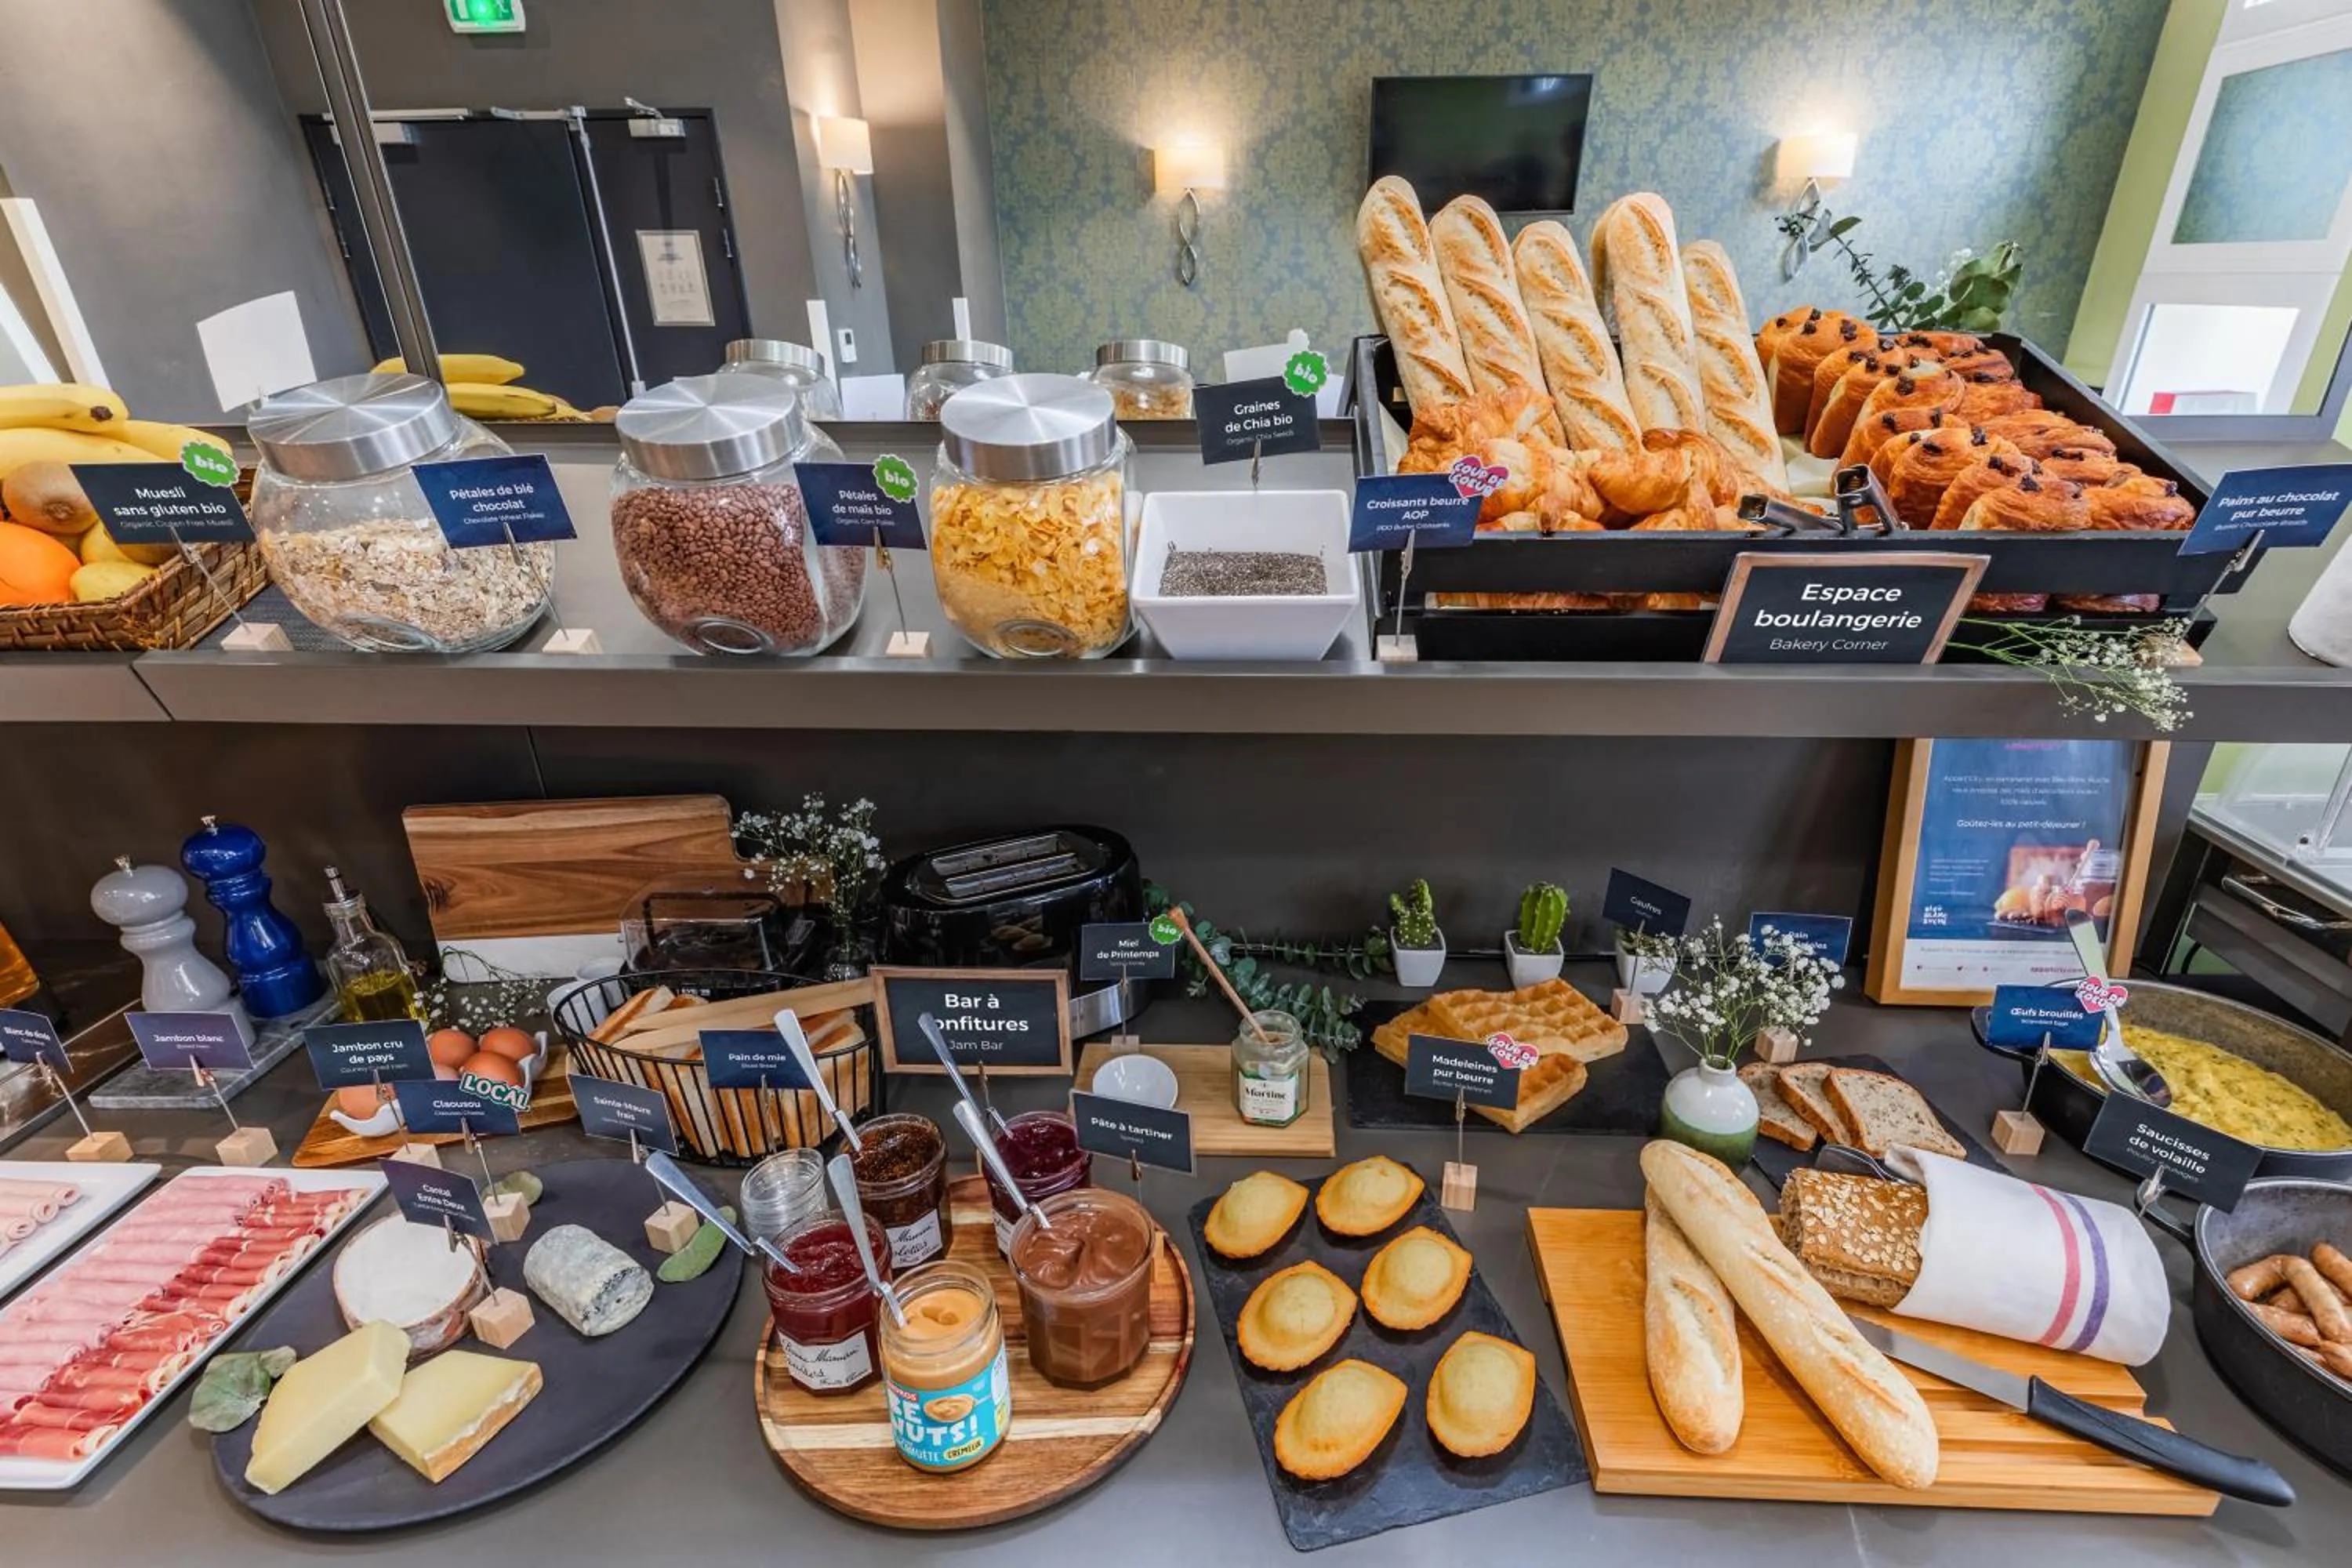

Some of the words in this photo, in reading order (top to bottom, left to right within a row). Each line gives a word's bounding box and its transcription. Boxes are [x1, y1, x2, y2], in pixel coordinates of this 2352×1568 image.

[1293, 363, 1318, 384] bio
[1234, 400, 1281, 416] Graines
[1225, 423, 1241, 434] de
[1243, 418, 1271, 431] Chia
[1273, 415, 1293, 426] bio
[194, 454, 228, 474] bio
[884, 469, 909, 488] bio
[1454, 463, 1487, 478] COUP
[1487, 474, 1506, 488] DE
[135, 486, 187, 500] Muesli
[449, 486, 495, 501] Pétales
[496, 483, 513, 496] de
[514, 481, 534, 495] blé
[838, 490, 878, 502] Pétales
[473, 499, 526, 514] chocolat
[1367, 498, 1427, 510] Croissants
[1429, 496, 1471, 508] beurre
[2217, 495, 2256, 509] Pains
[2256, 495, 2274, 505] au
[2276, 490, 2340, 503] chocolat
[113, 506, 147, 517] sans
[150, 503, 199, 518] gluten
[200, 503, 227, 515] bio
[832, 503, 845, 514] de
[848, 504, 873, 515] maïs
[874, 504, 892, 516] bio
[1401, 510, 1429, 521] AOP
[2230, 510, 2259, 522] pur
[2259, 506, 2305, 518] beurre
[1801, 583, 1902, 605] Espace
[1754, 609, 1923, 633] boulangerie
[1769, 638, 1829, 653] Bakery
[1832, 638, 1889, 652] Corner
[1156, 923, 1178, 936] bio
[1118, 939, 1140, 949] Miel
[1110, 950, 1160, 961] Printemps
[945, 993, 982, 1009] Bar
[987, 993, 1001, 1010] à
[2010, 1007, 2038, 1018] Œufs
[2038, 1009, 2083, 1020] brouillés
[934, 1015, 1029, 1032] onfitures
[153, 1034, 195, 1043] Jambon
[195, 1033, 225, 1043] blanc
[949, 1040, 978, 1051] Jam
[981, 1040, 1005, 1051] Bar
[332, 1041, 381, 1054] Jambon
[383, 1040, 404, 1051] cru
[349, 1054, 365, 1065] de
[367, 1053, 395, 1066] pays
[728, 1053, 752, 1063] Pain
[753, 1053, 767, 1063] de
[767, 1053, 787, 1063] mie
[1432, 1054, 1498, 1075] Madeleines
[1432, 1068, 1454, 1080] pur
[1455, 1070, 1494, 1085] beurre
[464, 1075, 531, 1110] LOCAL
[1091, 1116, 1117, 1131] Pâte
[1119, 1121, 1127, 1134] à
[1128, 1124, 1174, 1142] tartiner
[2136, 1123, 2211, 1162] Saucisses
[2128, 1136, 2150, 1149] de
[2151, 1146, 2206, 1175] volaille
[892, 1414, 978, 1447] NUTS!
